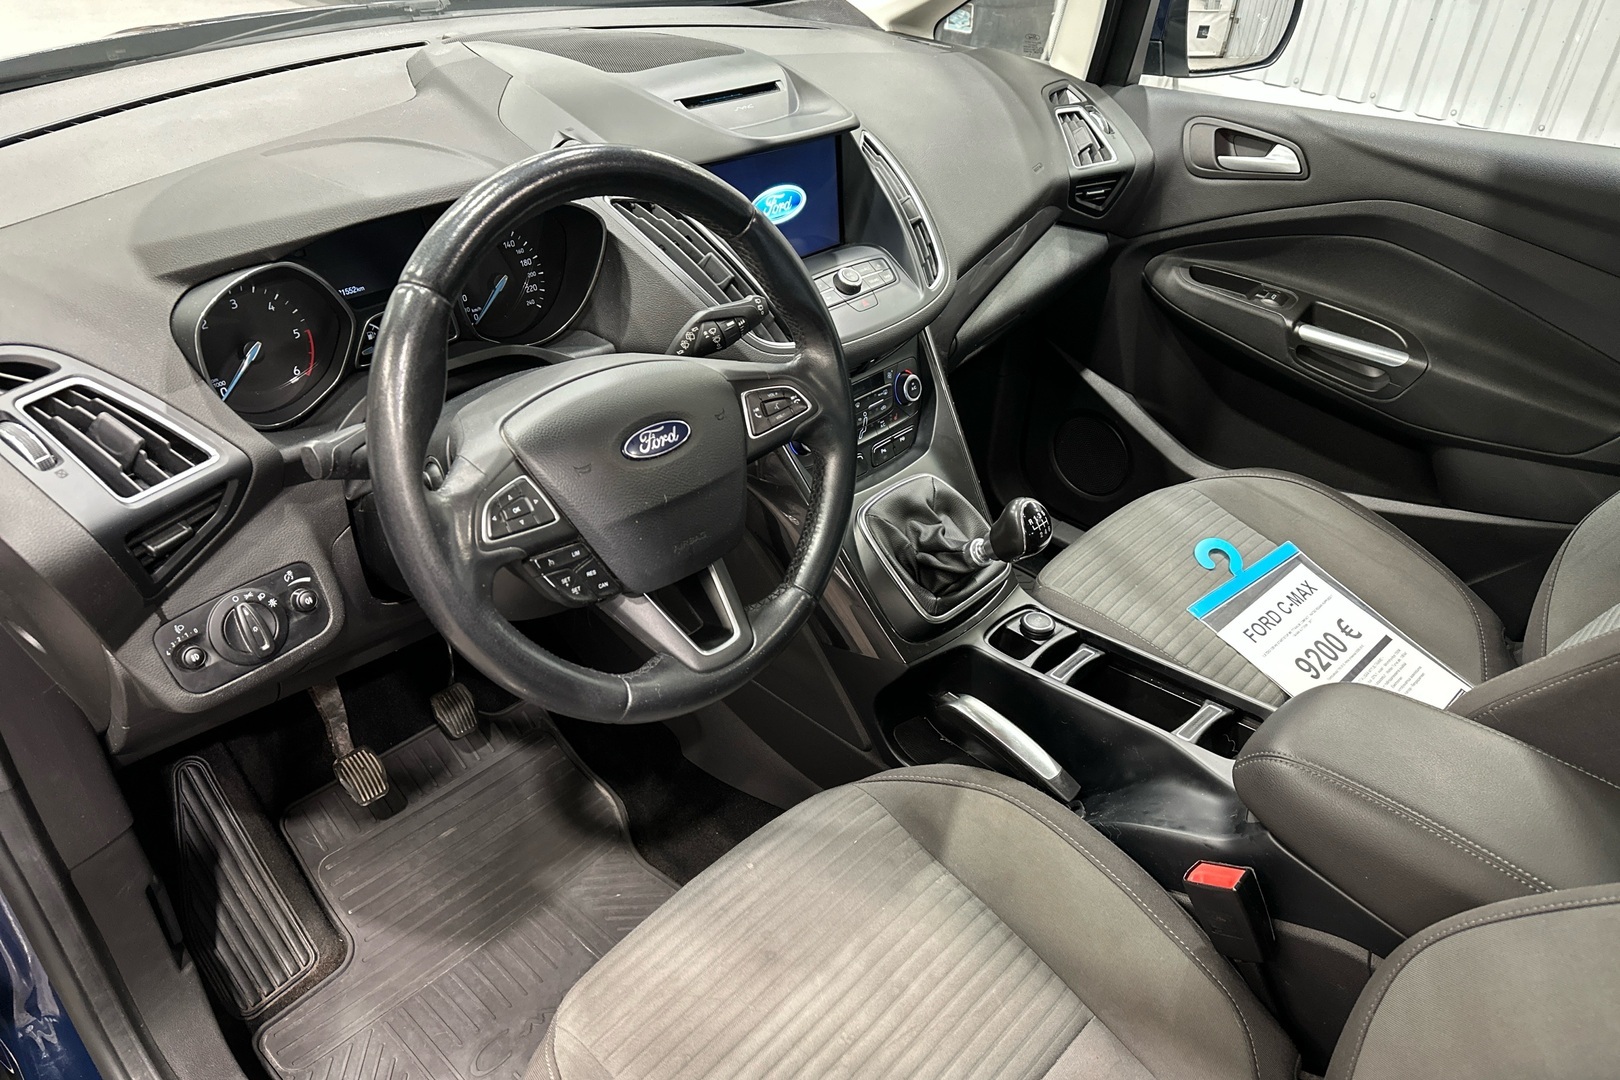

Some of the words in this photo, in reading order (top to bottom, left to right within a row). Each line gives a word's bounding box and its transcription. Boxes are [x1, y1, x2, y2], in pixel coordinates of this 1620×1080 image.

[762, 193, 793, 214] Ford
[503, 240, 516, 249] 140
[515, 247, 525, 255] 160
[520, 258, 532, 267] 180
[526, 284, 538, 293] 220
[230, 299, 238, 310] 3
[268, 302, 276, 312] 4
[473, 313, 480, 321] 0
[201, 320, 209, 330] 2
[293, 328, 301, 339] 5
[293, 365, 301, 376] 6
[639, 426, 679, 454] Ford
[512, 506, 521, 514] OK
[1027, 518, 1034, 526] R
[571, 550, 581, 558] LIM
[586, 569, 597, 577] RES
[598, 581, 609, 589] CAN
[1242, 610, 1282, 644] FORD
[1276, 580, 1318, 615] C-MAX
[1294, 632, 1348, 680] 9200
[1336, 618, 1363, 639] €
